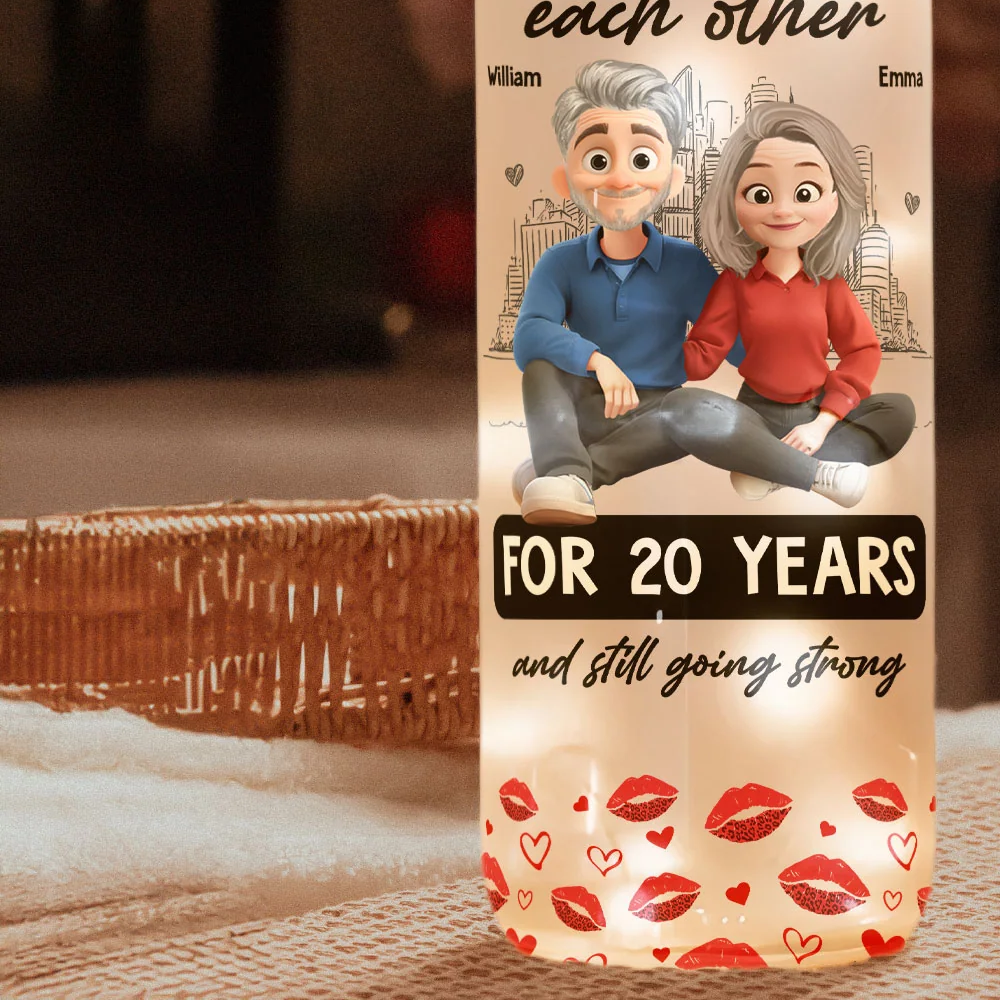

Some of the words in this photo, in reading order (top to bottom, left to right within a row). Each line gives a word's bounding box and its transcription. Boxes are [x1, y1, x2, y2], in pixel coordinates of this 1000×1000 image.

[487, 64, 542, 88] William
[878, 65, 924, 88] Emma
[502, 535, 599, 596] FOR
[629, 537, 702, 596] 20
[732, 534, 916, 596] YEARS
[512, 638, 585, 685] and
[582, 635, 660, 688] still
[660, 649, 782, 698] going
[786, 635, 907, 698] strong
